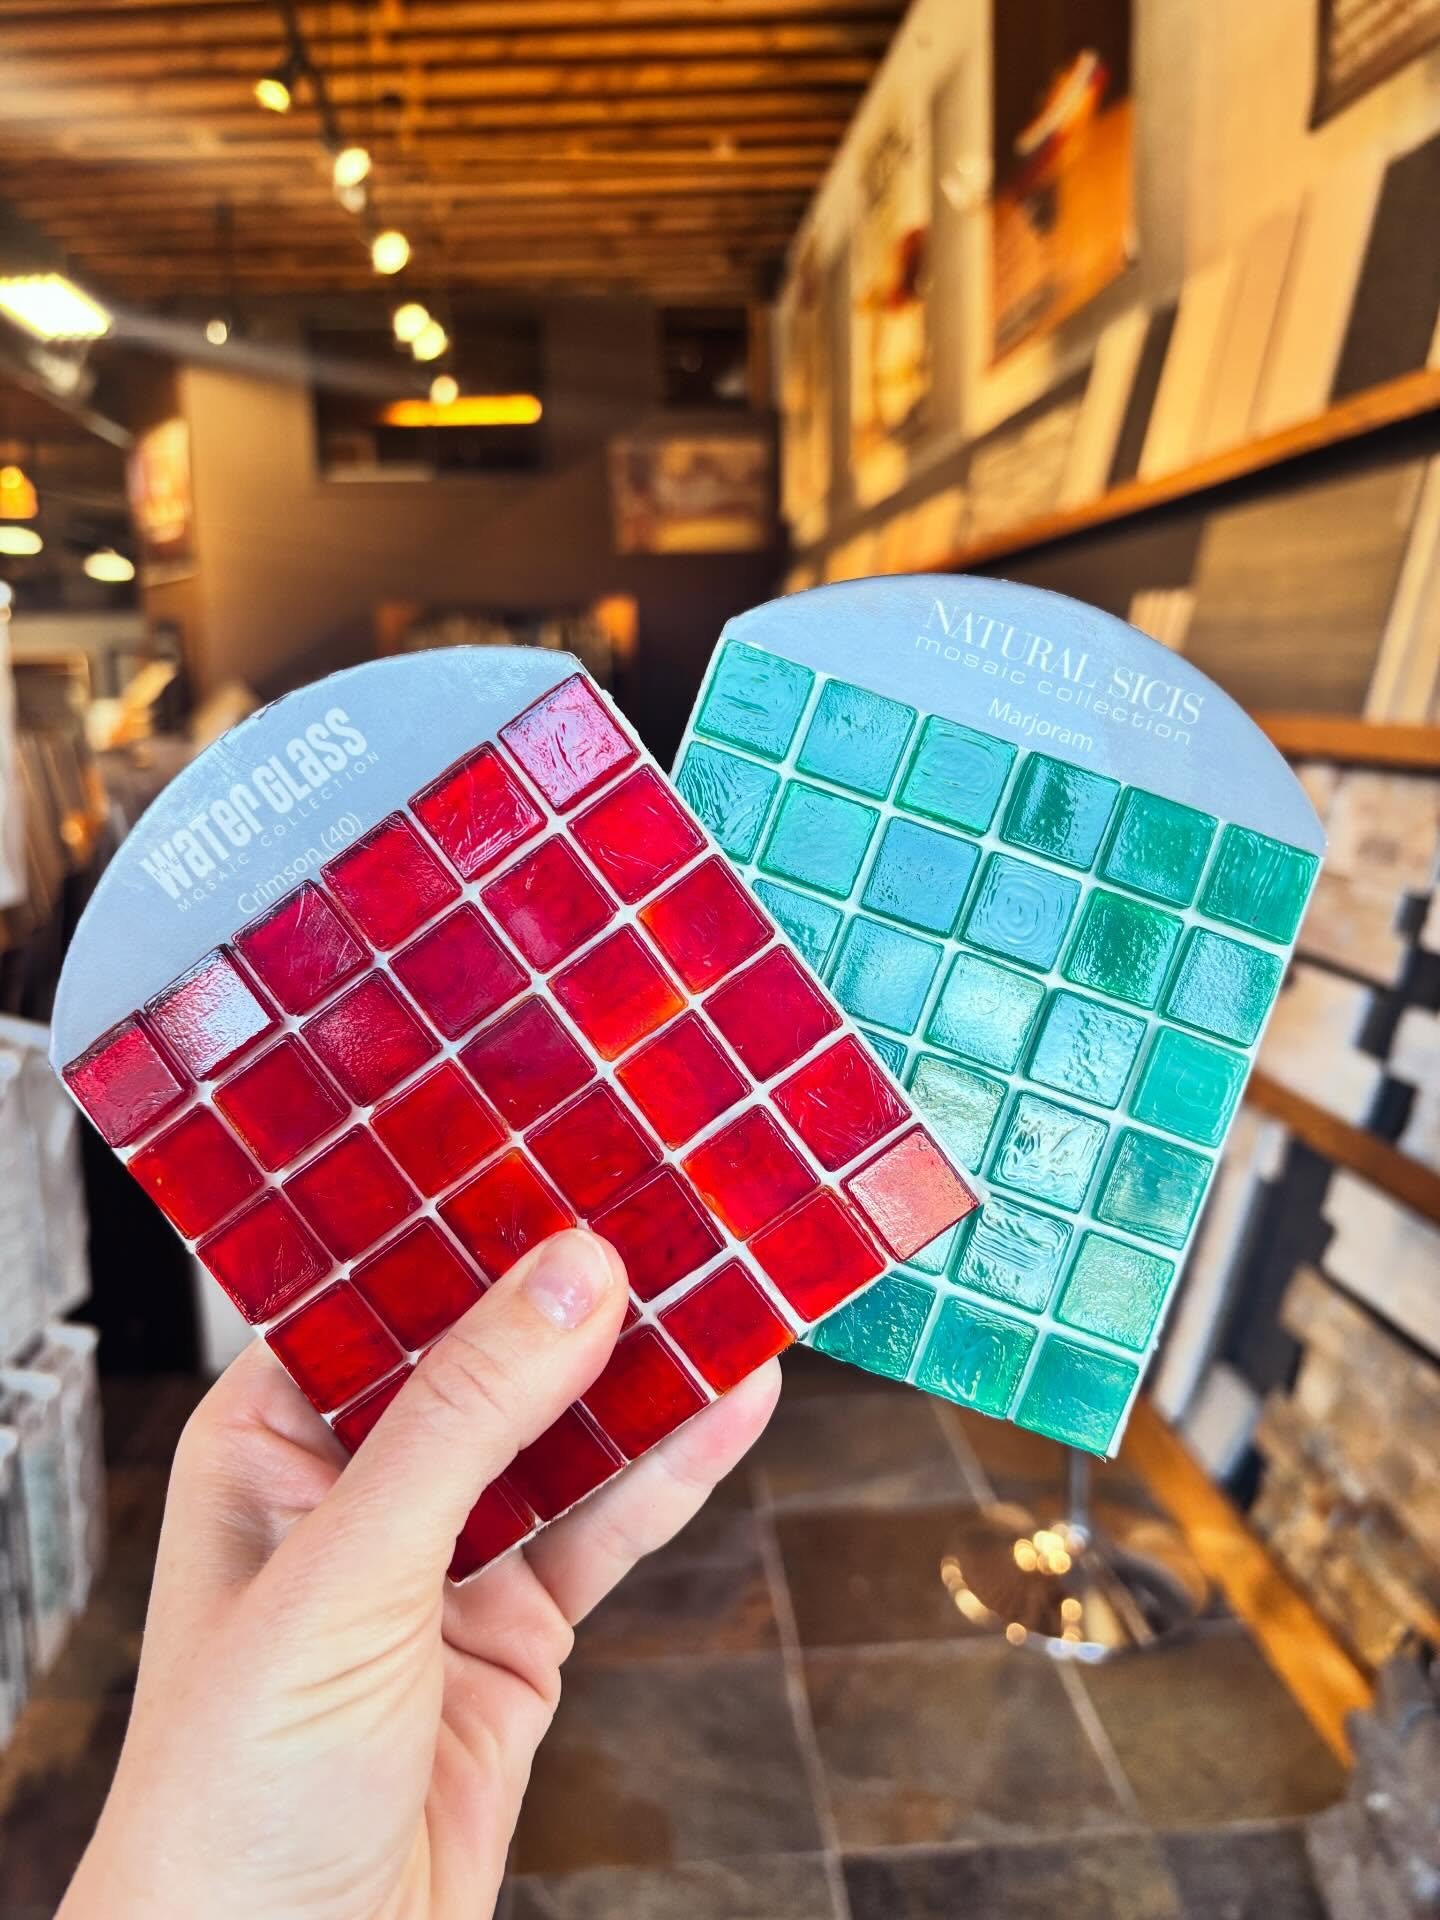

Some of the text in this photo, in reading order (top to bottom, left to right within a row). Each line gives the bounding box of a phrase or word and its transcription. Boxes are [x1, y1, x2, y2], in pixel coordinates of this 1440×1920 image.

[915, 635, 1192, 745] mosaic collection
[923, 599, 1204, 725] NATURAL SICIS
[987, 698, 1093, 752] Marjoram
[177, 751, 380, 912] MOSAIC COLLECTION
[237, 811, 364, 914] Crimson (40)
